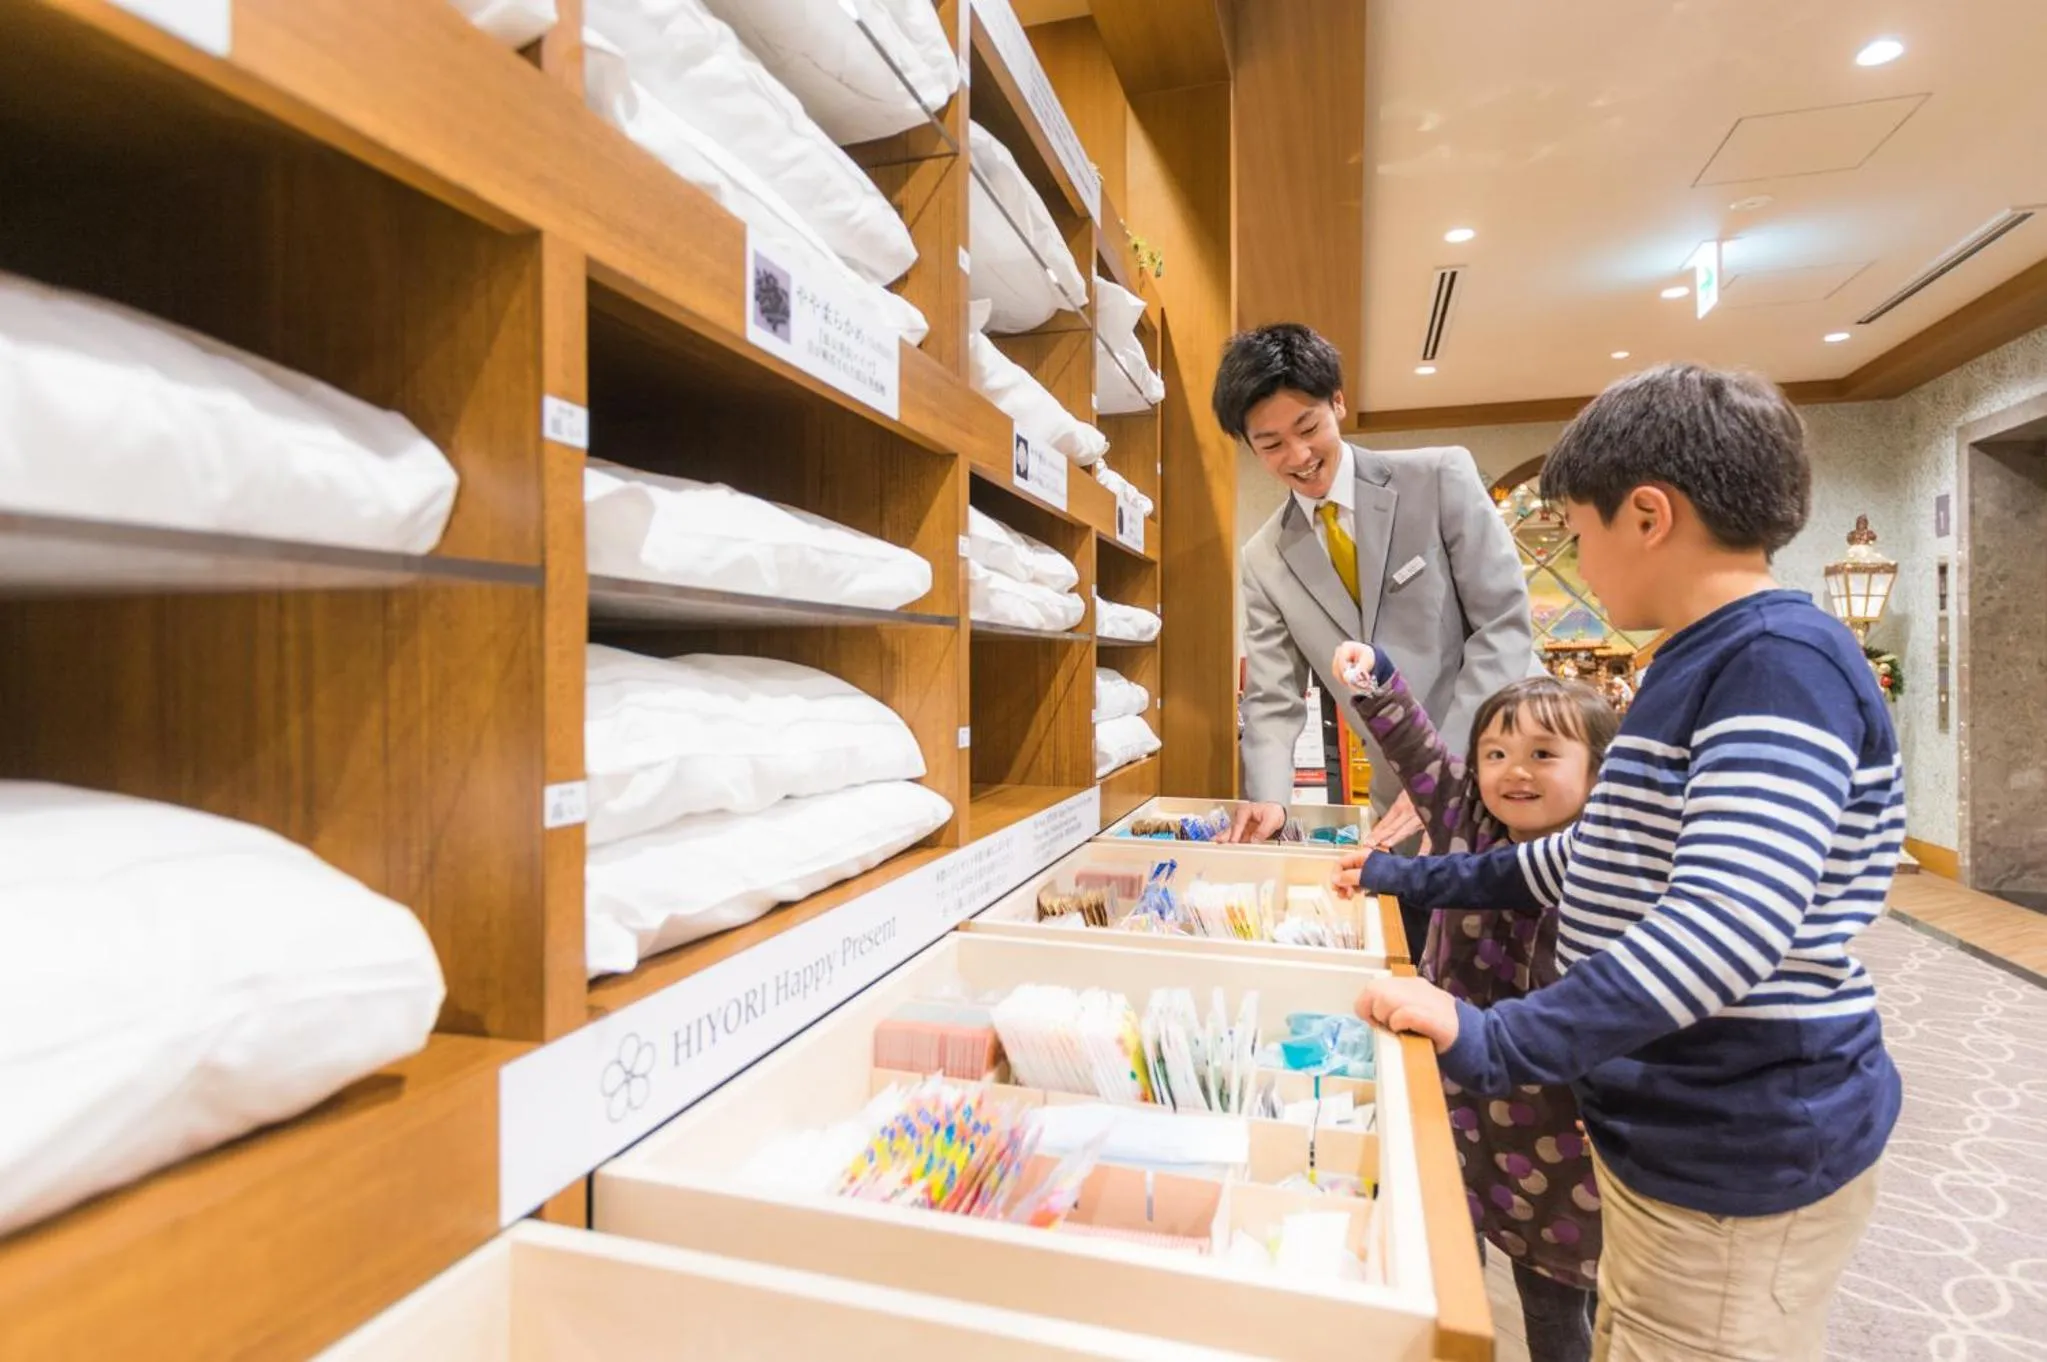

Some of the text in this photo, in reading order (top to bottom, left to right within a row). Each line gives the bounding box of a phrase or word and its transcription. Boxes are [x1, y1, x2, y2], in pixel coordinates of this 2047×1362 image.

[672, 916, 897, 1067] HIYORI Happy Present
